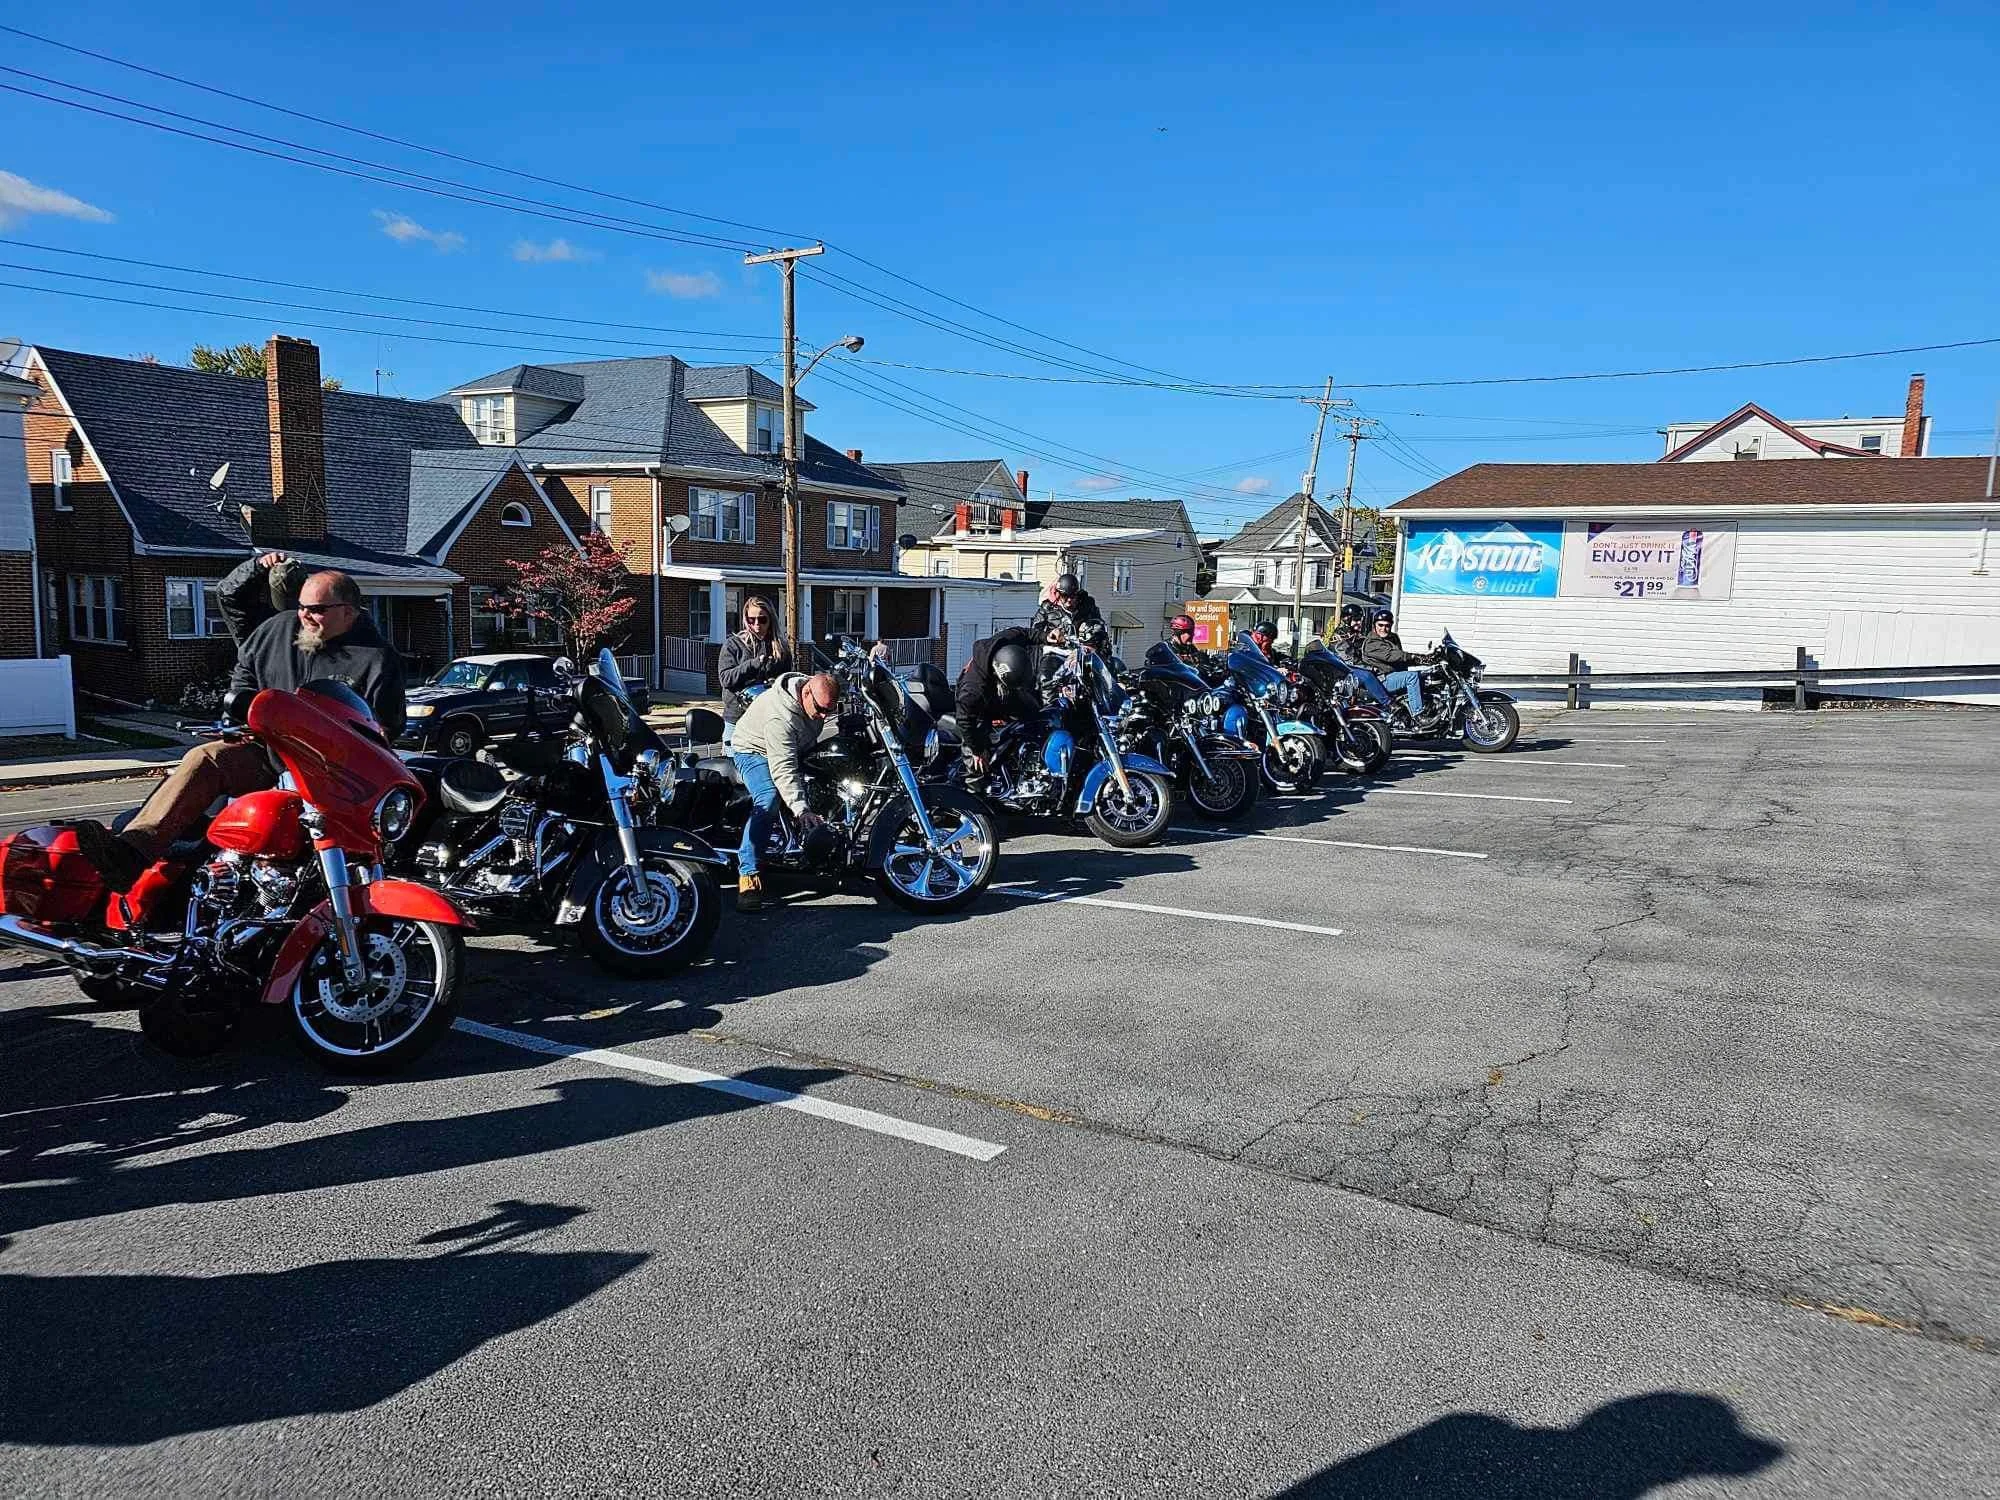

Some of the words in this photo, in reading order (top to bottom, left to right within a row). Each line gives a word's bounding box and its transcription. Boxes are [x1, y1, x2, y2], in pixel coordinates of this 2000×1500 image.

[1416, 543, 1542, 573] KEYSTONE
[1592, 550, 1653, 563] ENJOY
[1658, 550, 1675, 563] IT
[1490, 577, 1539, 594] LIGHT
[1187, 604, 1196, 613] Ice
[1196, 604, 1208, 613] and
